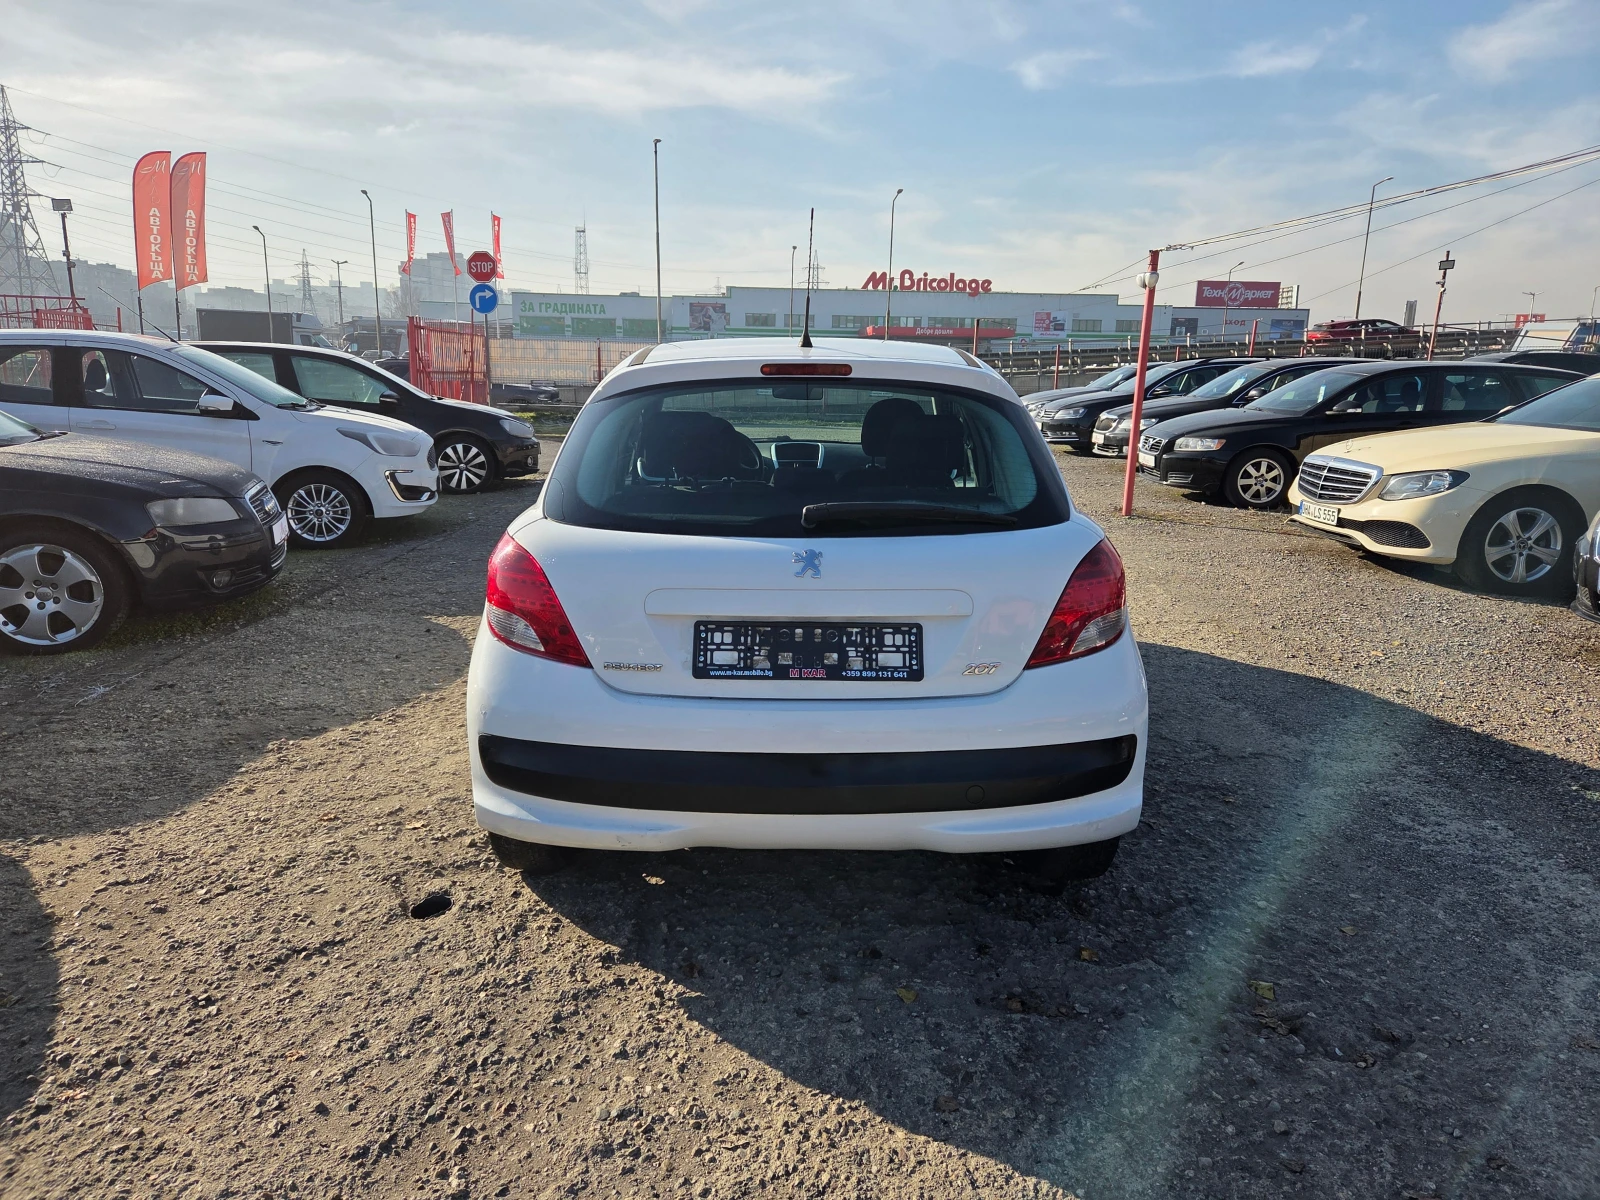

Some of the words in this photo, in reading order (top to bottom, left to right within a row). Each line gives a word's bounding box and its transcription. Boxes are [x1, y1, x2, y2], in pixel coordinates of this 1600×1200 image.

[149, 207, 163, 279] АВТОКЪЩА
[185, 209, 198, 282] АВТОКЪЩА
[470, 261, 493, 273] STOP
[520, 300, 535, 313] ЗА
[538, 302, 607, 316] ГРАДИНАТА
[915, 327, 934, 336] Добре
[1313, 506, 1322, 519] LS
[1322, 509, 1336, 523] 555
[604, 661, 663, 672] PEUGEOT
[709, 669, 773, 677] www.m-kar.mobile.bg
[790, 668, 800, 678] M
[802, 668, 827, 678] KAR
[962, 661, 1001, 675] 207
